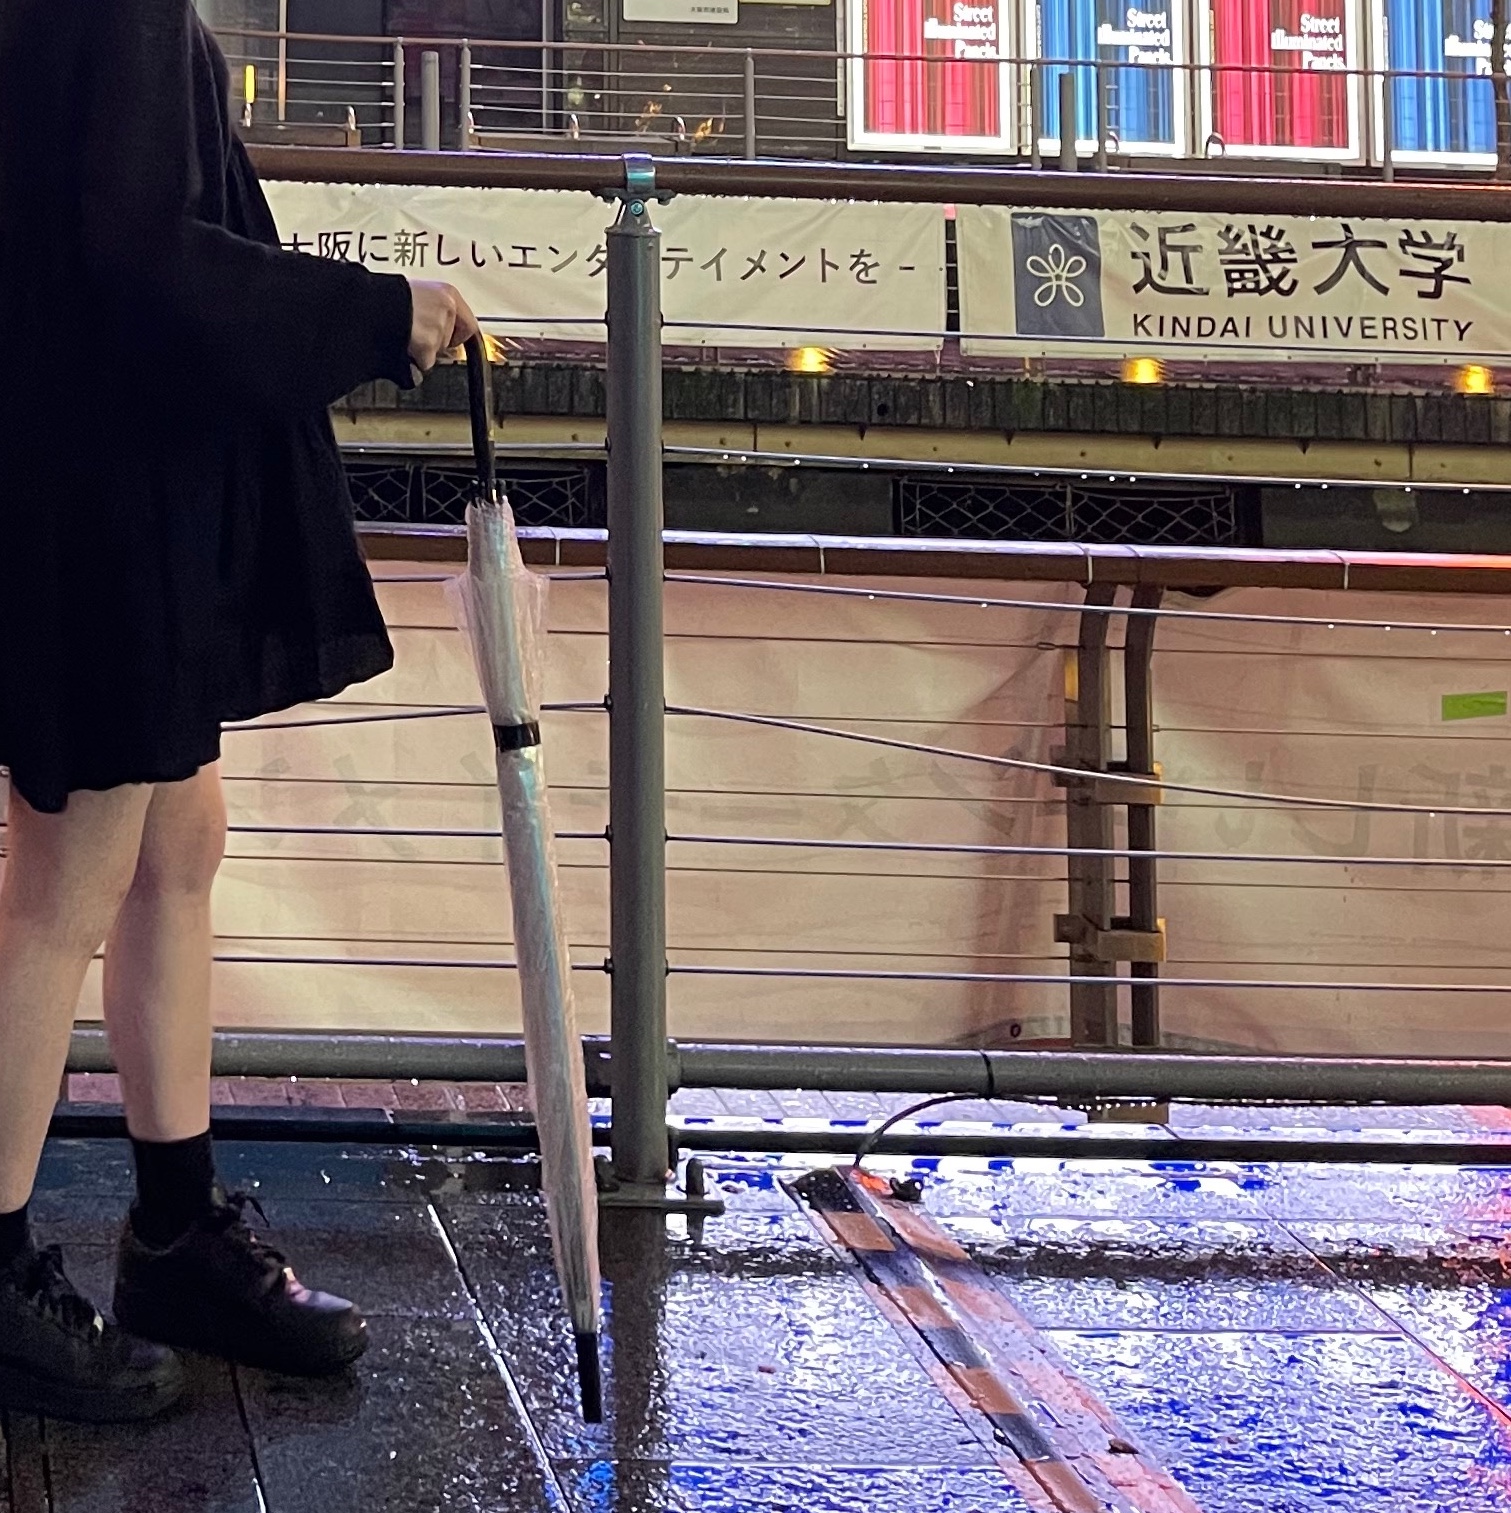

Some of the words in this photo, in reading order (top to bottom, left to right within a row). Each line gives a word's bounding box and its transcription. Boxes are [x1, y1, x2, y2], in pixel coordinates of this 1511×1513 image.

[1130, 221, 1473, 300] 近畿大学
[1133, 313, 1251, 339] KINDAI
[1268, 315, 1474, 342] UNIVERSITY
